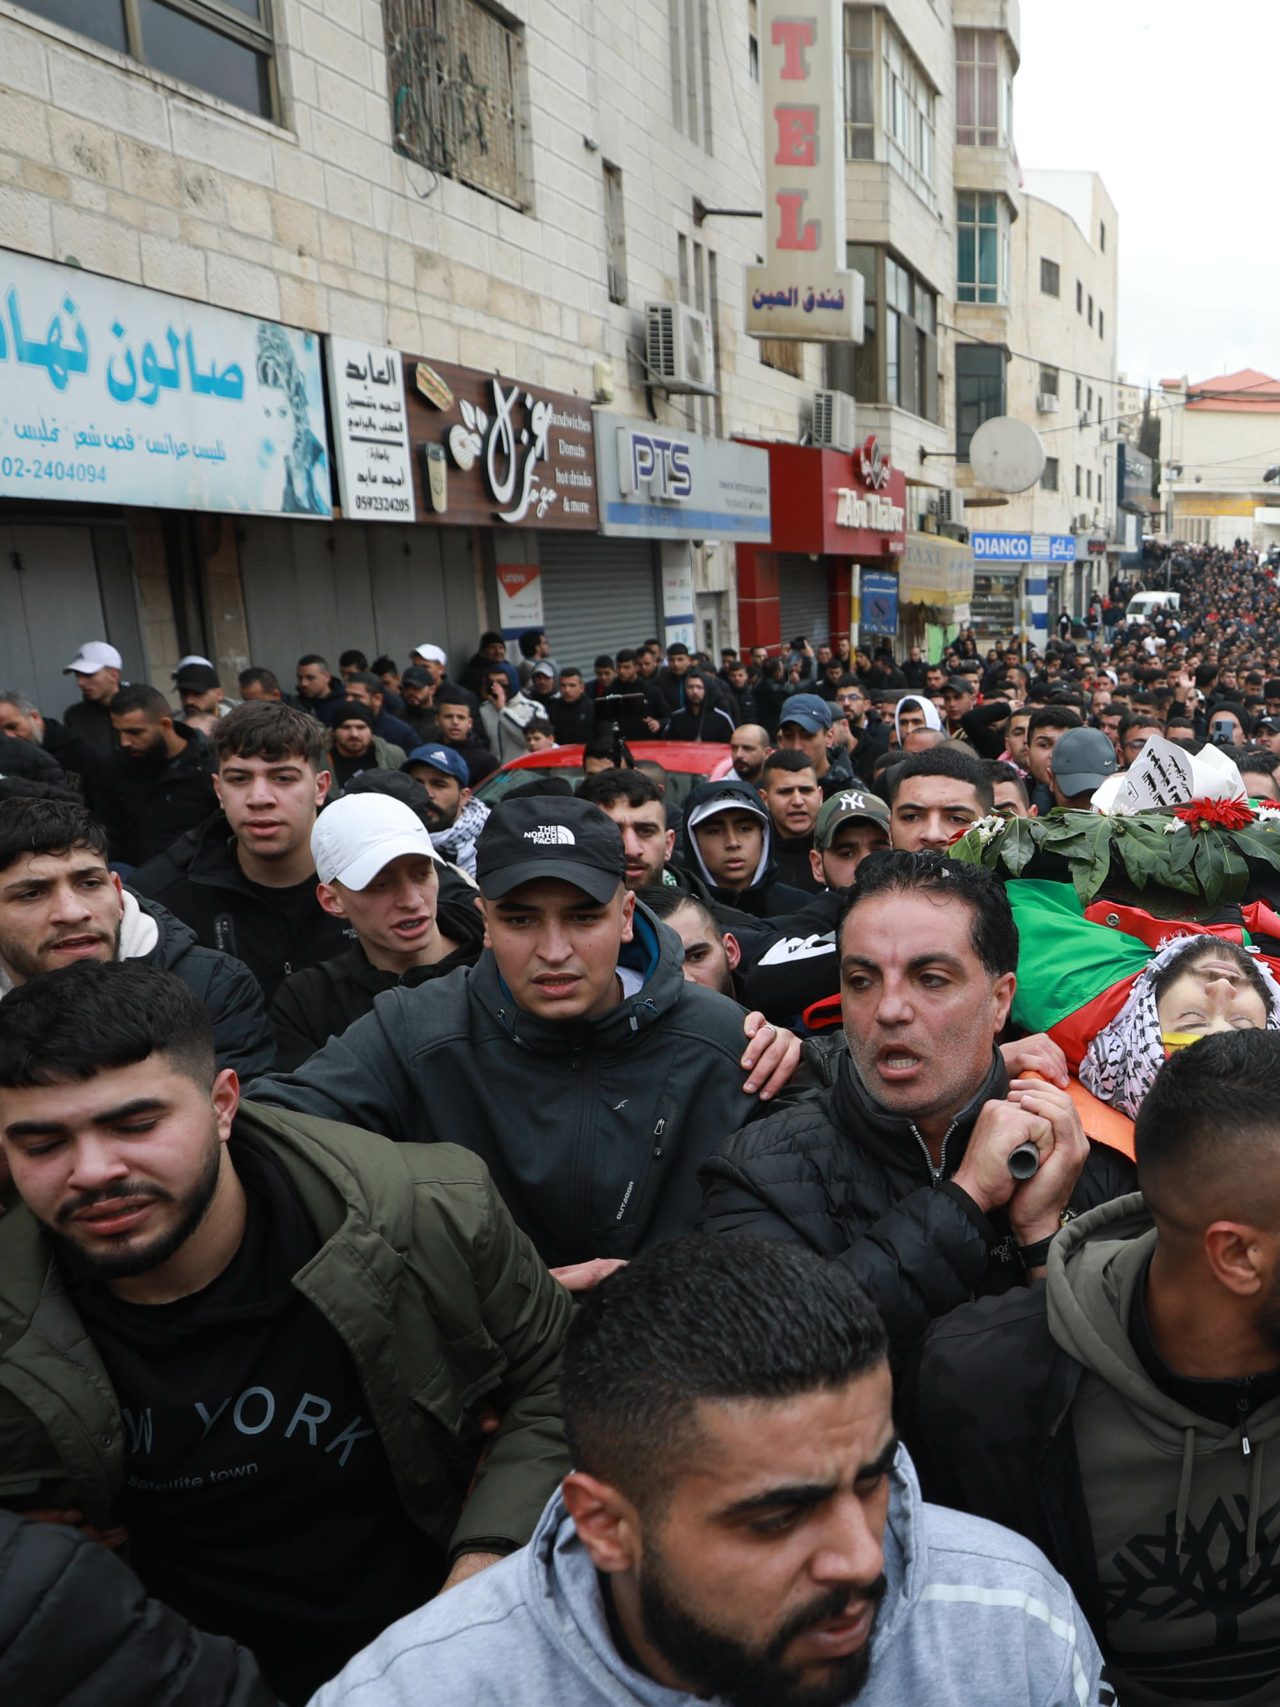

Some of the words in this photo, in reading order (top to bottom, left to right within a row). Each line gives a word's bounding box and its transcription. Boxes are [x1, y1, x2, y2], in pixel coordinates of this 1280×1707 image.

[751, 286, 798, 312] العين
[802, 285, 845, 313] فندق
[107, 321, 244, 406] صالون
[345, 352, 396, 390] العابد
[558, 439, 586, 460] Donuts
[1, 455, 107, 484] 02-2404094
[555, 467, 569, 483] hot
[569, 468, 592, 487] drinks
[631, 432, 693, 497] PTS
[563, 496, 570, 512] &
[570, 500, 590, 513] more
[974, 537, 1028, 556] DIANCO
[537, 825, 557, 833] THE
[194, 1386, 376, 1467] YORK
[208, 1462, 259, 1482] town
